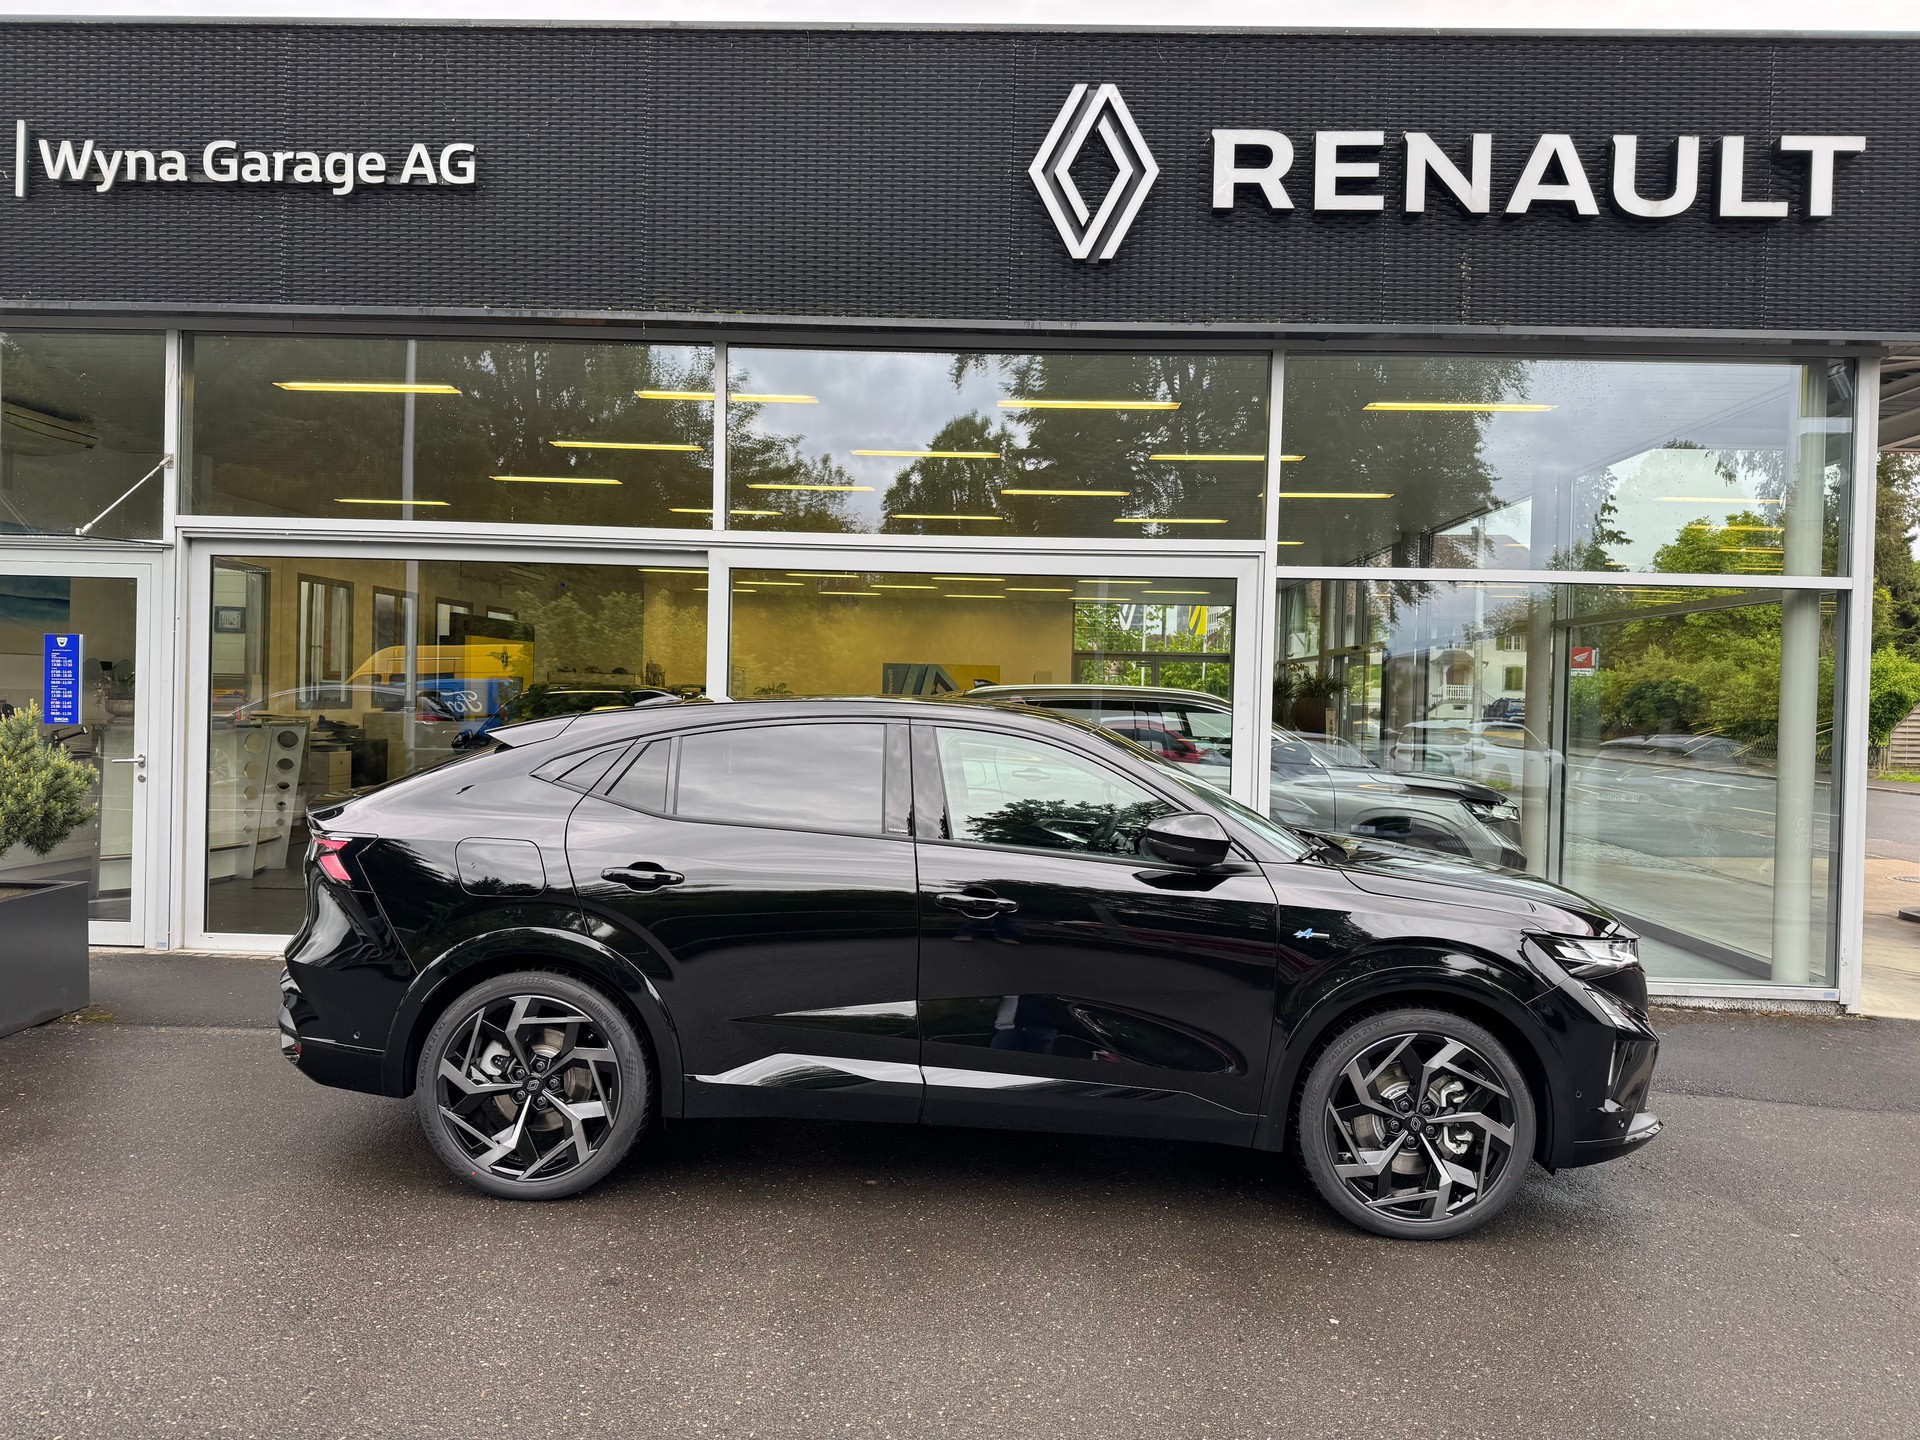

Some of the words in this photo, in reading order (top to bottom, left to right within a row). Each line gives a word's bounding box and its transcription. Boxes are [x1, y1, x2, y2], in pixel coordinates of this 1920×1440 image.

[38, 139, 188, 193] Wyna
[202, 140, 386, 196] Garage
[399, 142, 476, 186] AG
[1211, 129, 1867, 218] RENAULT
[577, 994, 621, 1033] Continental
[420, 1052, 430, 1088] 245/40
[437, 1021, 448, 1033] XL
[1326, 1037, 1354, 1066] 245/40
[1353, 1032, 1362, 1040] R
[1361, 1026, 1372, 1035] 21
